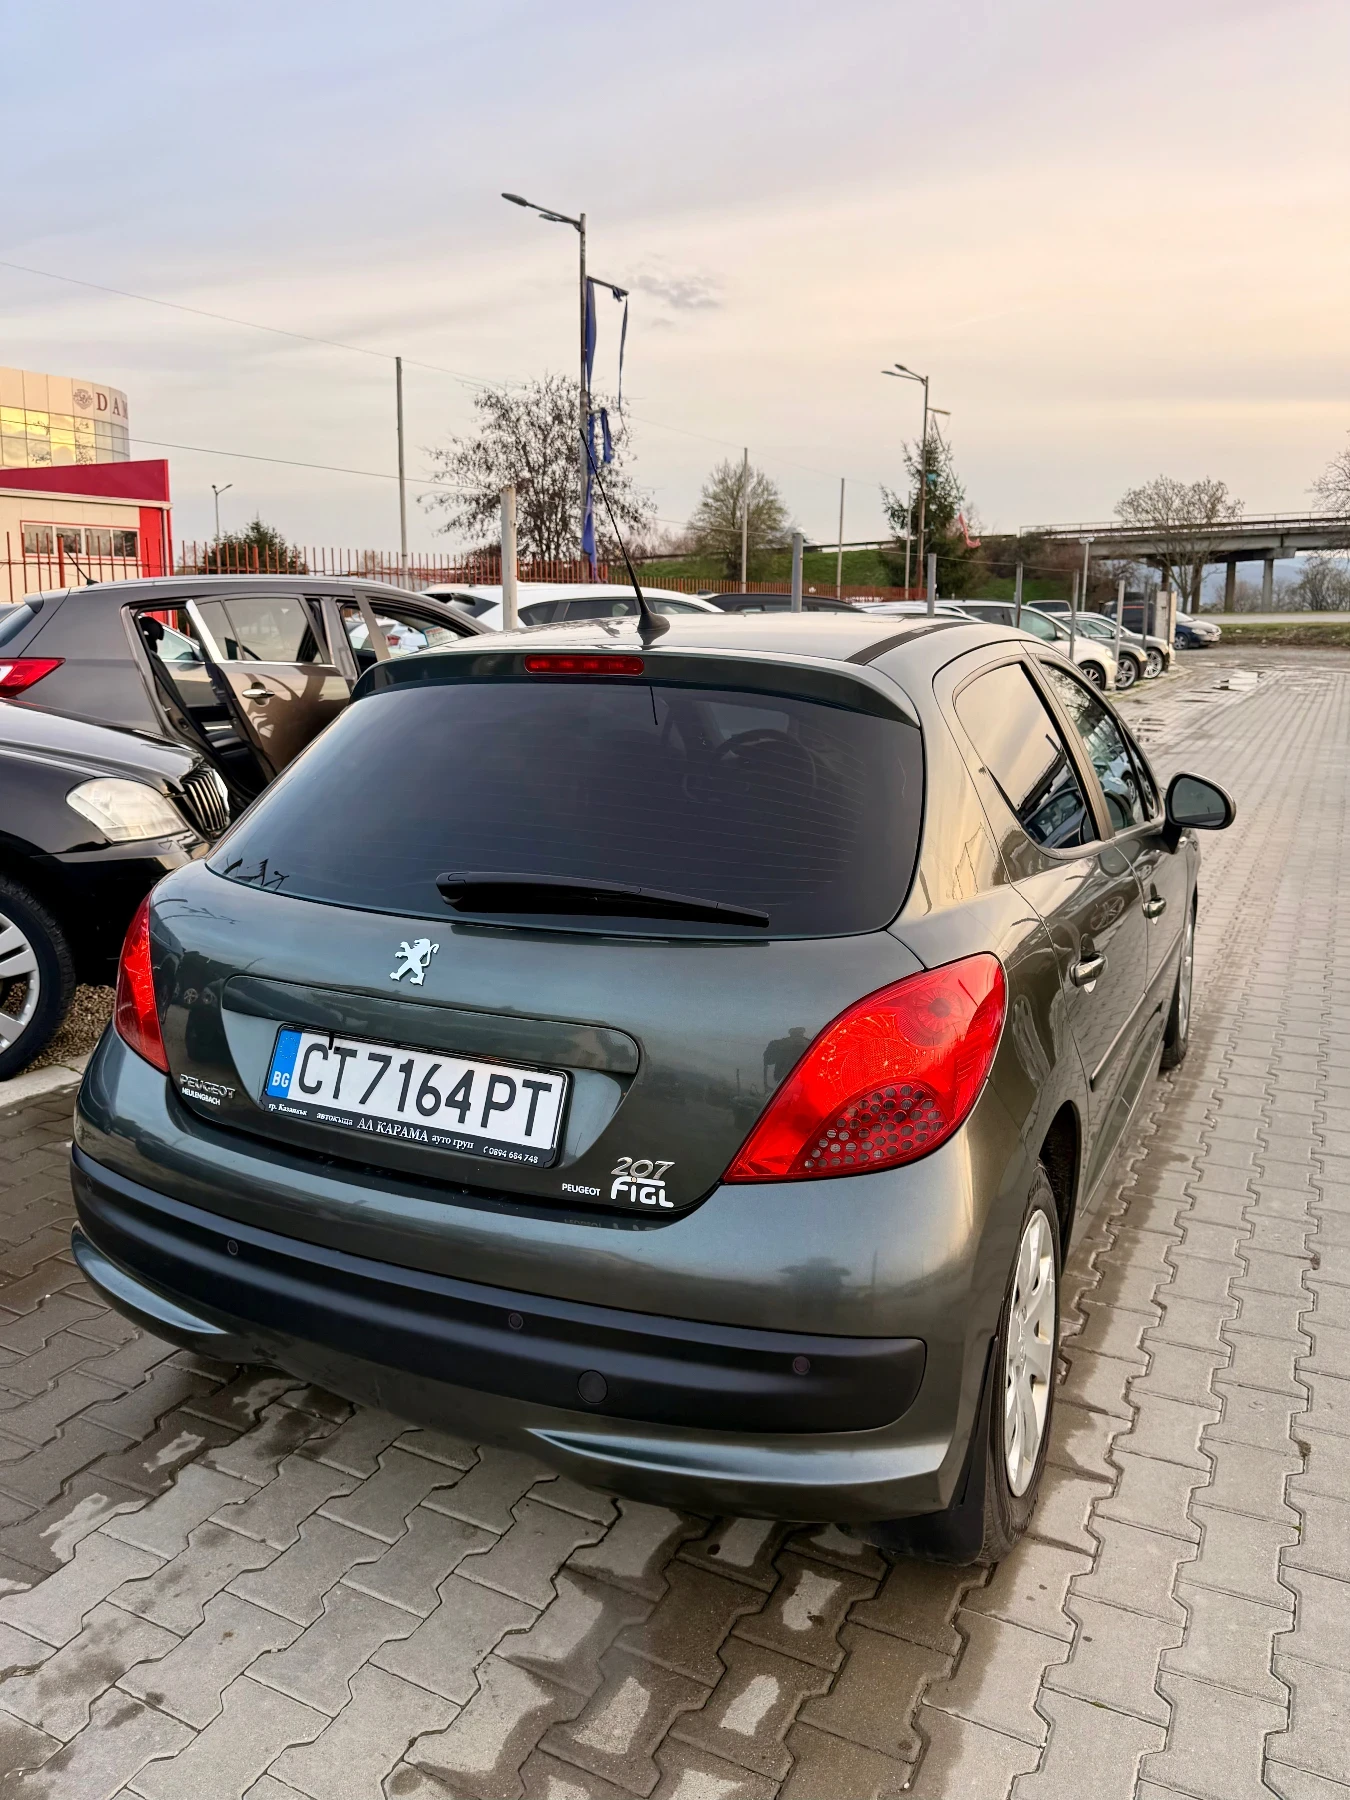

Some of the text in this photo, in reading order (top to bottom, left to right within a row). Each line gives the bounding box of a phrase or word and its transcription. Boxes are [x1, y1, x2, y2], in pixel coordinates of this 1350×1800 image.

[179, 1073, 236, 1099] PEUGEOT
[271, 1070, 290, 1088] BG
[181, 1087, 221, 1106] NEULENGBACH
[356, 1117, 374, 1131] АЛ
[375, 1120, 429, 1143] КАРАМА
[431, 1134, 452, 1145] ауто
[452, 1138, 475, 1150] груп
[610, 1156, 676, 1180] 207
[561, 1182, 601, 1197] PEUGEOT
